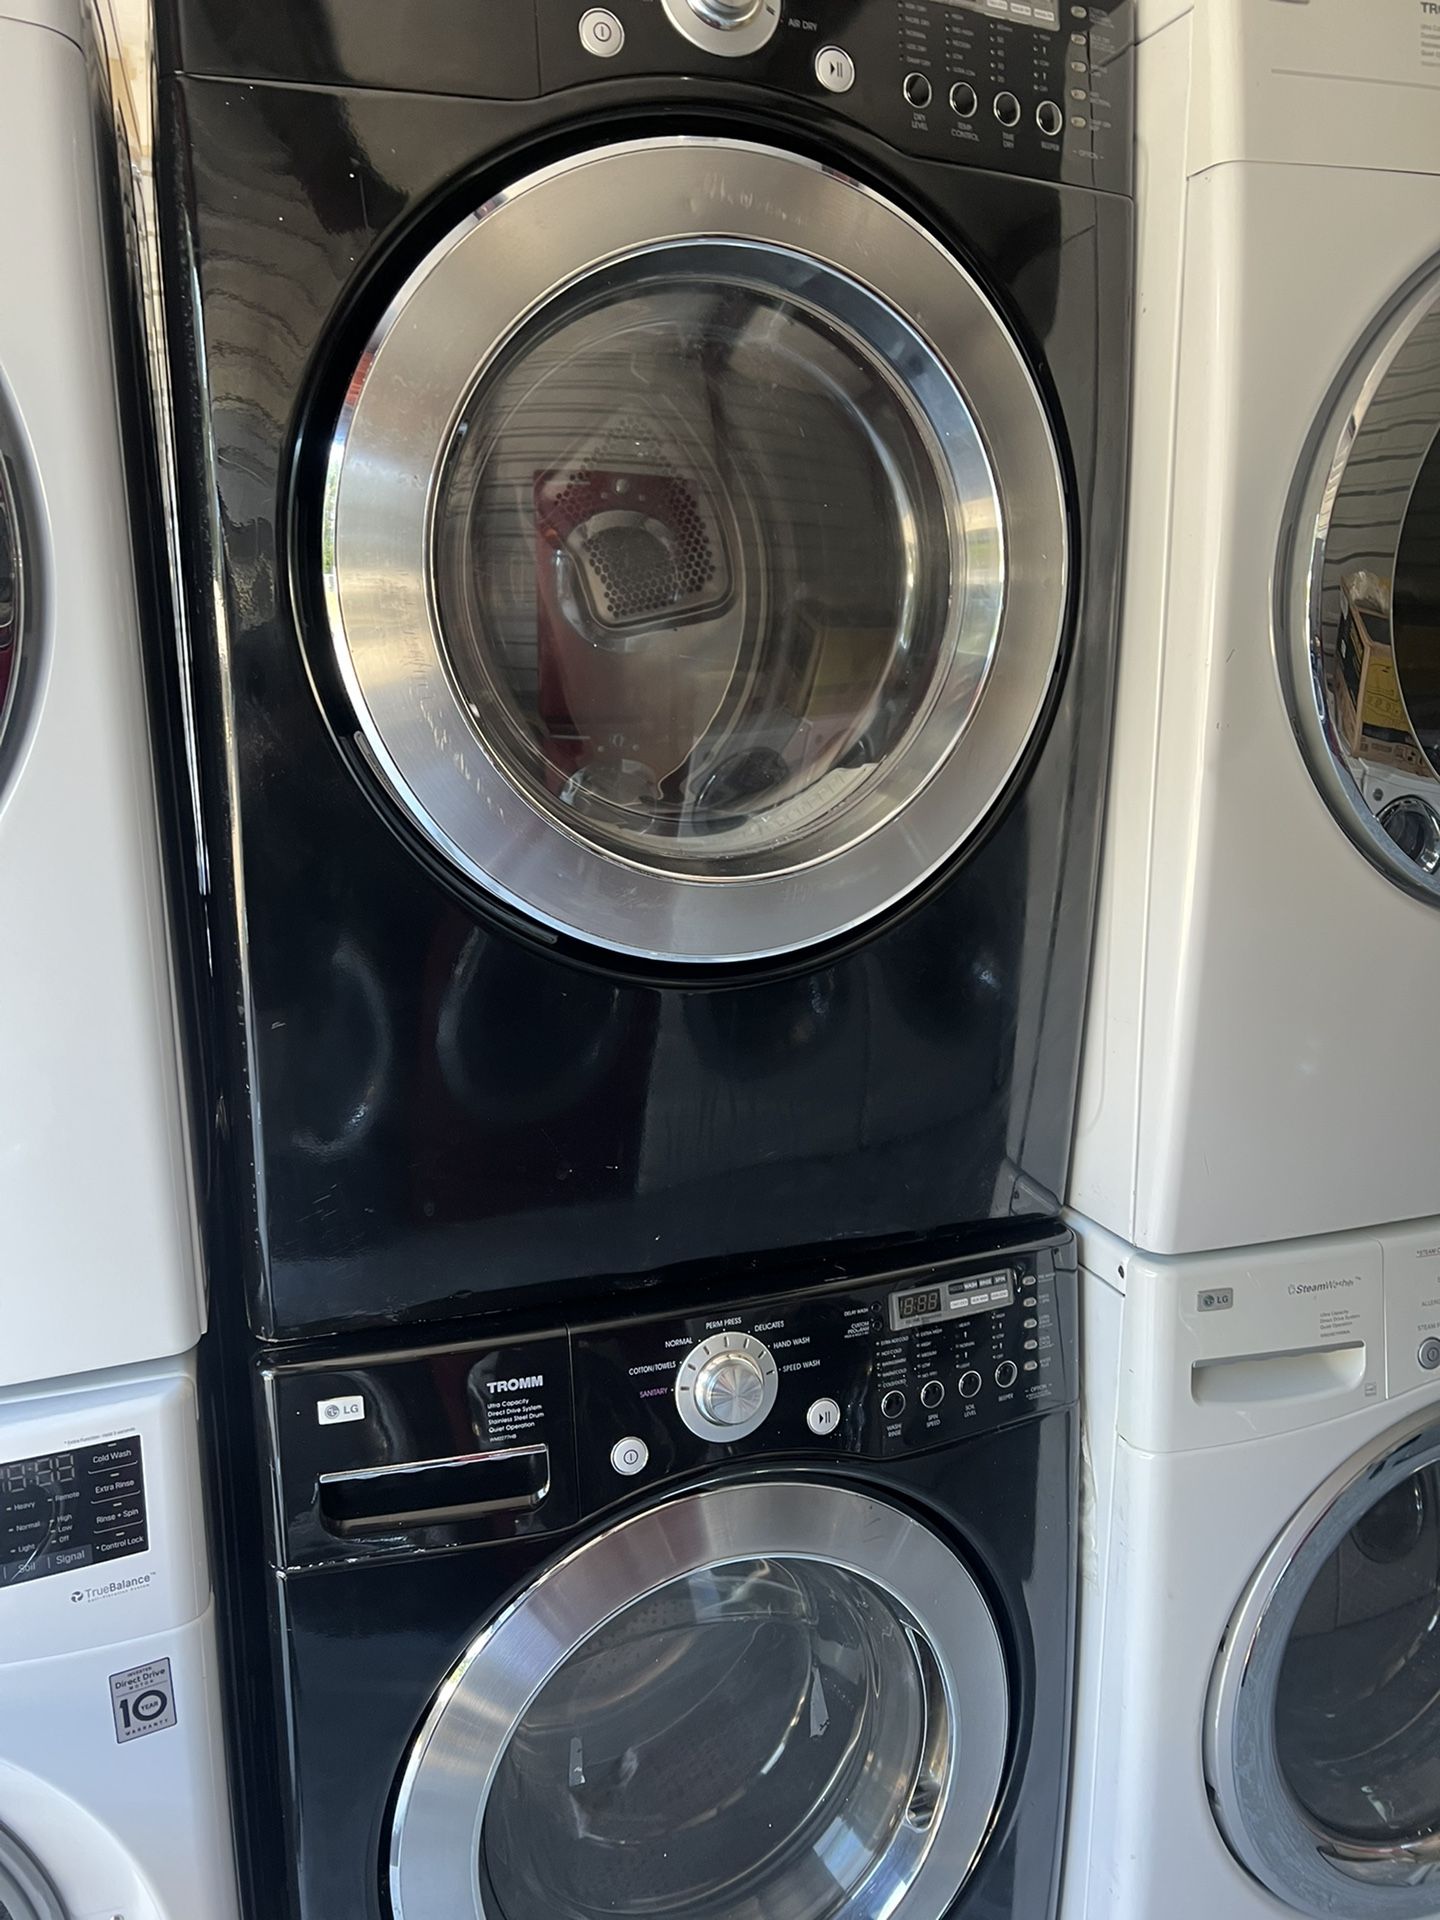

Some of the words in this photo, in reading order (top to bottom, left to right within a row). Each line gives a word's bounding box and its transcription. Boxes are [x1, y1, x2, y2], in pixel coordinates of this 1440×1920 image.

[788, 18, 801, 30] AIR
[802, 20, 818, 31] DRY
[913, 112, 926, 122] DRY
[911, 120, 928, 130] LEVEL
[951, 129, 980, 142] CONTROL
[1216, 1295, 1229, 1304] LG
[706, 1319, 722, 1330] PERM
[724, 1317, 742, 1327] PRESS
[754, 1320, 785, 1332] DELICATES
[665, 1337, 693, 1348] NORMAL
[773, 1340, 792, 1349] HAND
[792, 1336, 811, 1347] WASH
[629, 1361, 677, 1376] COTTON/TOWELS
[782, 1363, 801, 1373] SPEED
[802, 1360, 821, 1370] WASH
[487, 1375, 544, 1394] TROMM
[639, 1388, 668, 1399] SANITARY
[502, 1398, 530, 1408] Capacity
[343, 1404, 359, 1414] LG
[487, 1409, 506, 1417] Direct
[506, 1407, 521, 1415] Drive
[522, 1404, 543, 1413] System
[964, 1409, 977, 1418] LEVEL
[488, 1417, 513, 1426] Stainless
[513, 1414, 528, 1422] Steel
[926, 1419, 941, 1428] SPEED
[505, 1421, 536, 1431] Operation
[92, 1452, 110, 1464] Cold
[110, 1449, 132, 1460] Wash
[95, 1483, 115, 1494] Extra
[115, 1479, 135, 1490] Rinse
[55, 1491, 80, 1501] Remote
[14, 1502, 36, 1512] Heavy
[57, 1514, 73, 1524] High
[96, 1512, 116, 1524] Rinse
[122, 1508, 139, 1520] Spin
[16, 1521, 41, 1532] Normal
[57, 1523, 73, 1533] Low
[59, 1535, 70, 1544] Off
[127, 1535, 144, 1547] Lock
[18, 1543, 36, 1554] Light
[55, 1550, 86, 1566] Signal
[18, 1562, 36, 1573] Soil
[115, 1676, 141, 1690] Direct
[143, 1668, 166, 1681] Drive
[129, 1679, 154, 1690] MOTOR
[119, 1689, 168, 1728] 10
[140, 1701, 159, 1711] YEAR
[125, 1718, 169, 1736] WARRANTY
